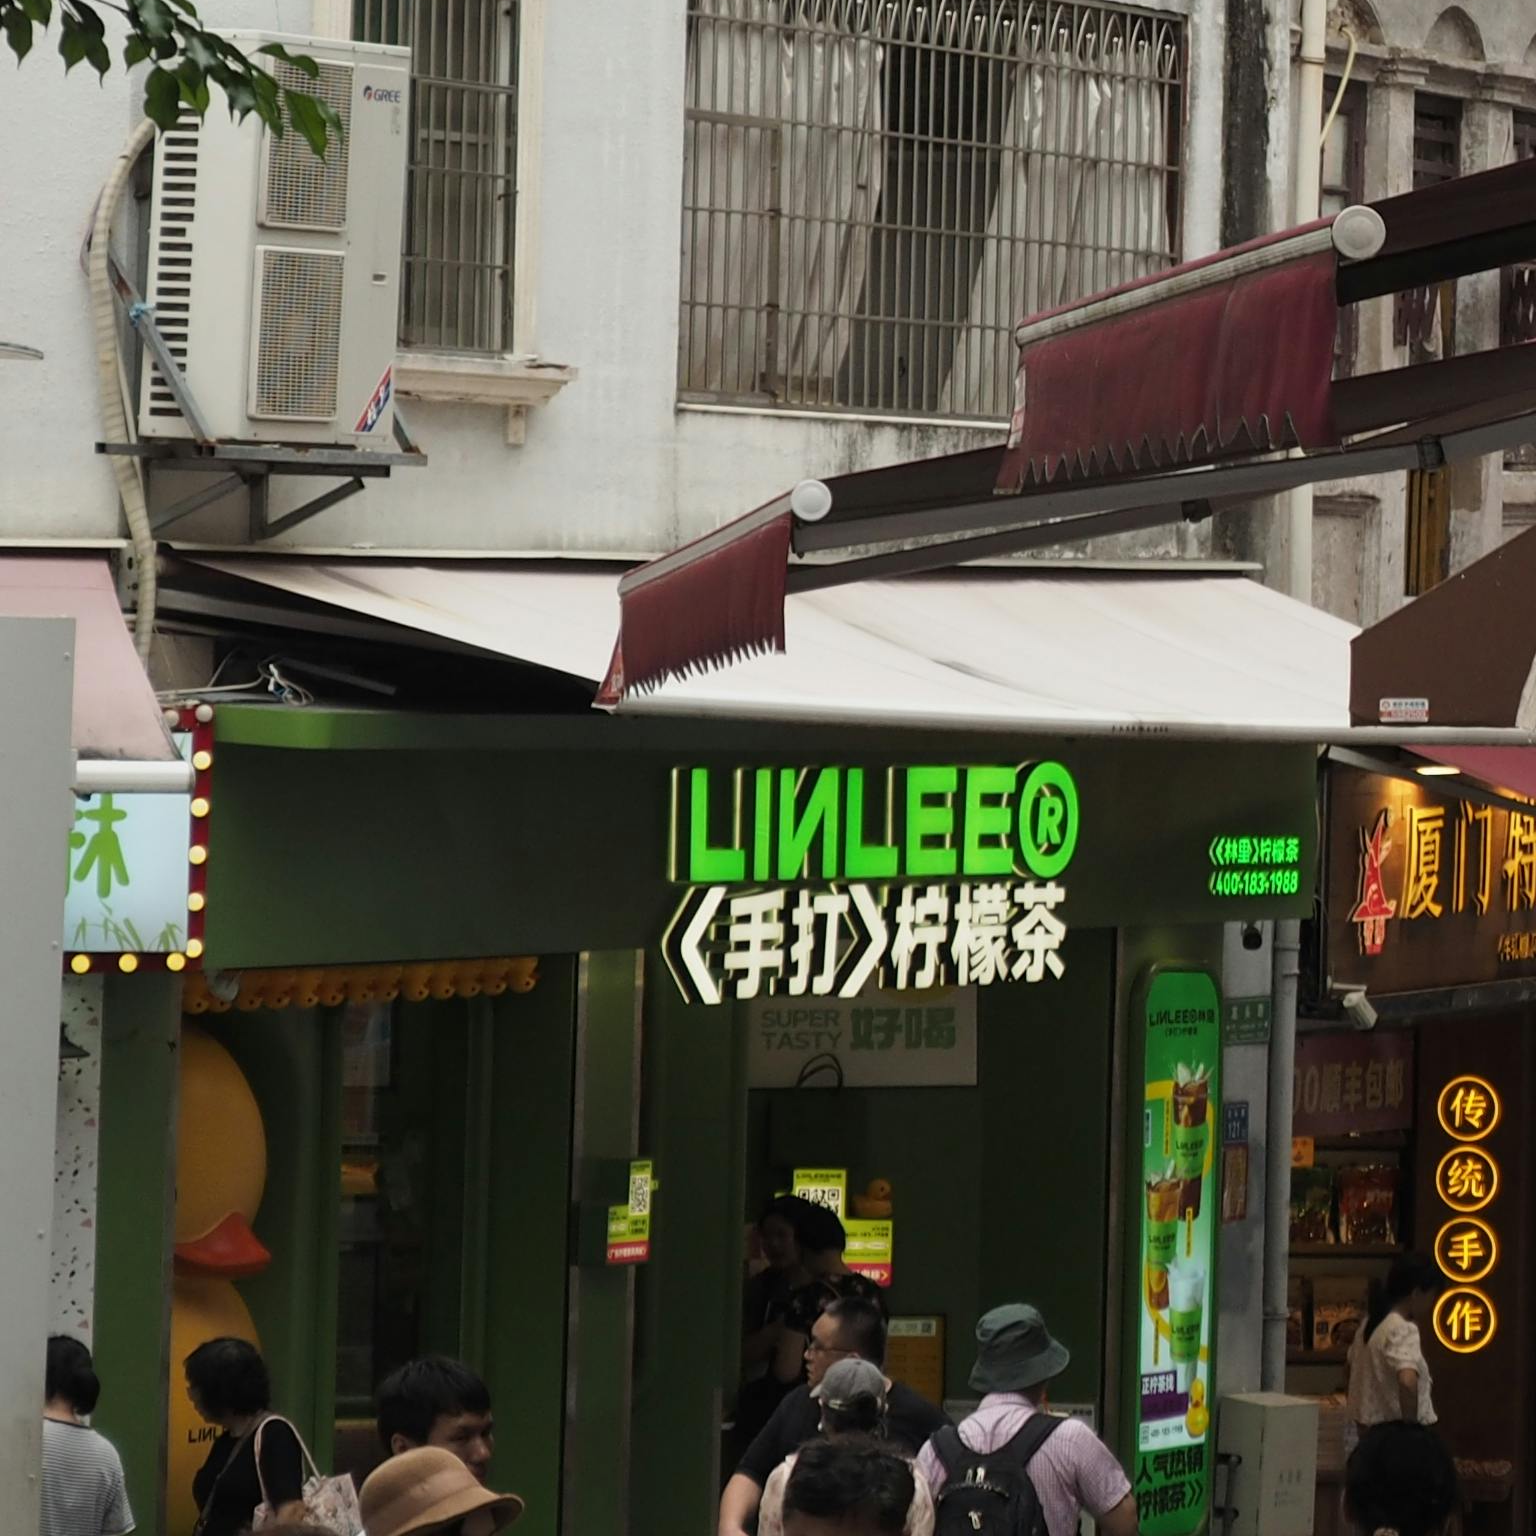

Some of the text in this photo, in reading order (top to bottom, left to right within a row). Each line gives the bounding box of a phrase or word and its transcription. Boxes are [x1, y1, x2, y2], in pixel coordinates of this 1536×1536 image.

[374, 88, 401, 103] GREE
[1215, 870, 1299, 895] 400-183-1988
[762, 1010, 839, 1028] SUPER
[851, 1007, 956, 1050] 好喝
[761, 1031, 842, 1050] TASTY
[1443, 1085, 1491, 1345] 传统手作
